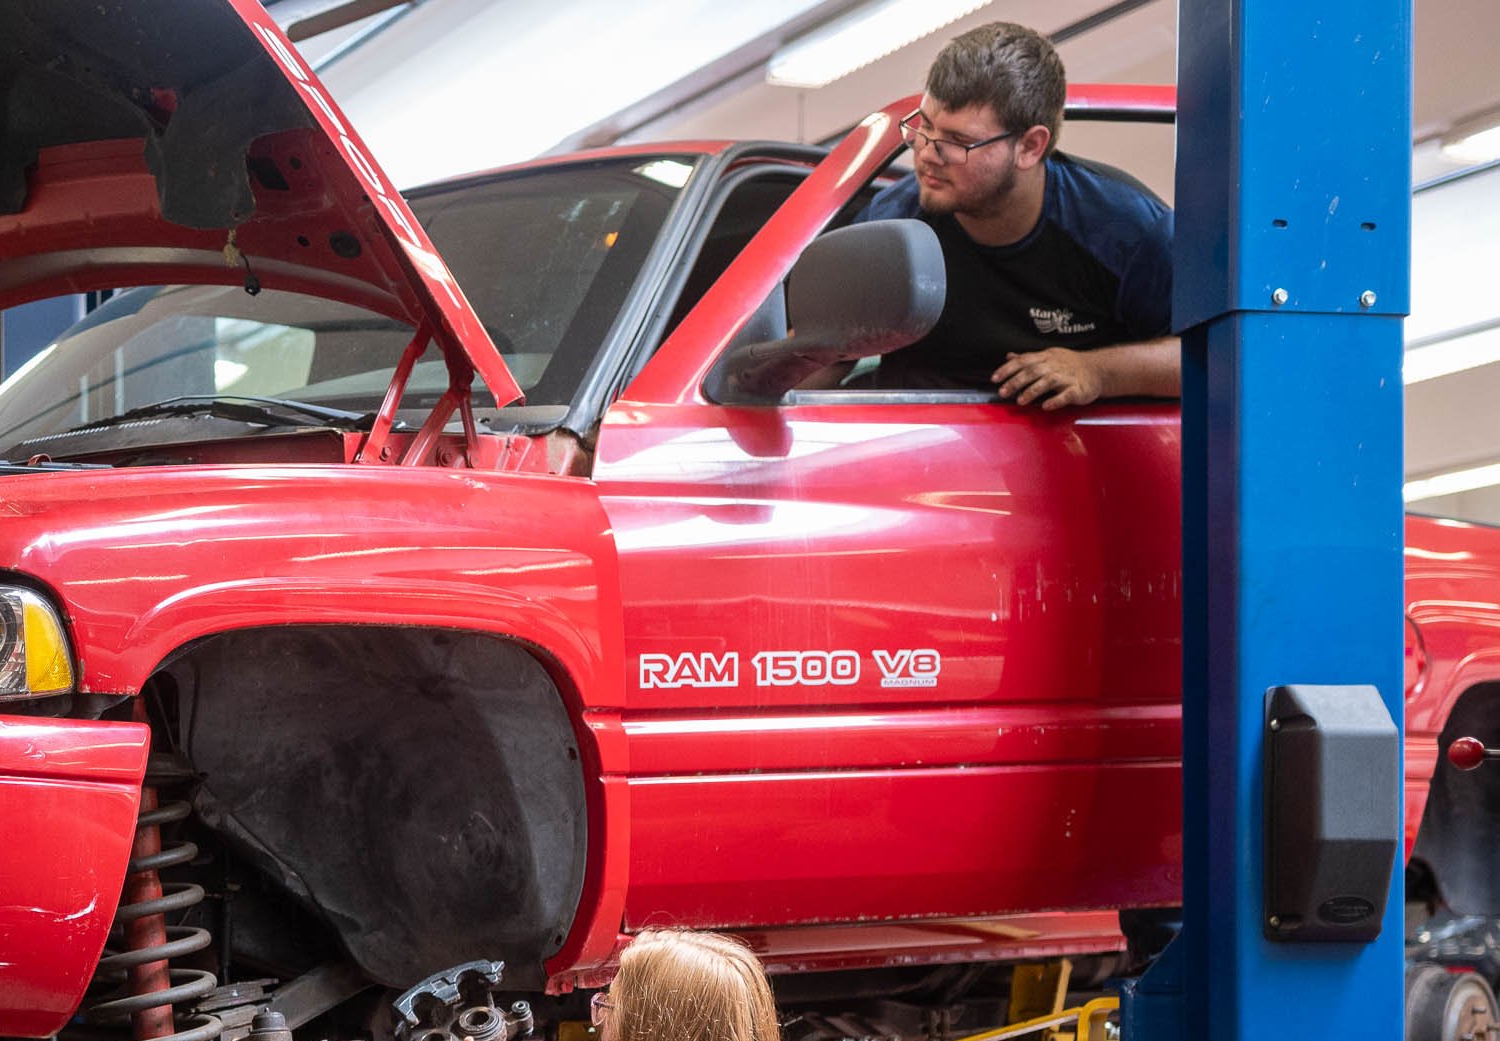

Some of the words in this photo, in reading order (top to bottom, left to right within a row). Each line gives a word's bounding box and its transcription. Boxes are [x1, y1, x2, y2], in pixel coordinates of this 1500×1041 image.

[253, 21, 462, 310] SPORT
[640, 652, 738, 688] RAM
[751, 650, 860, 686] 1500
[873, 649, 940, 679] V8
[882, 678, 936, 686] MAGNUM
